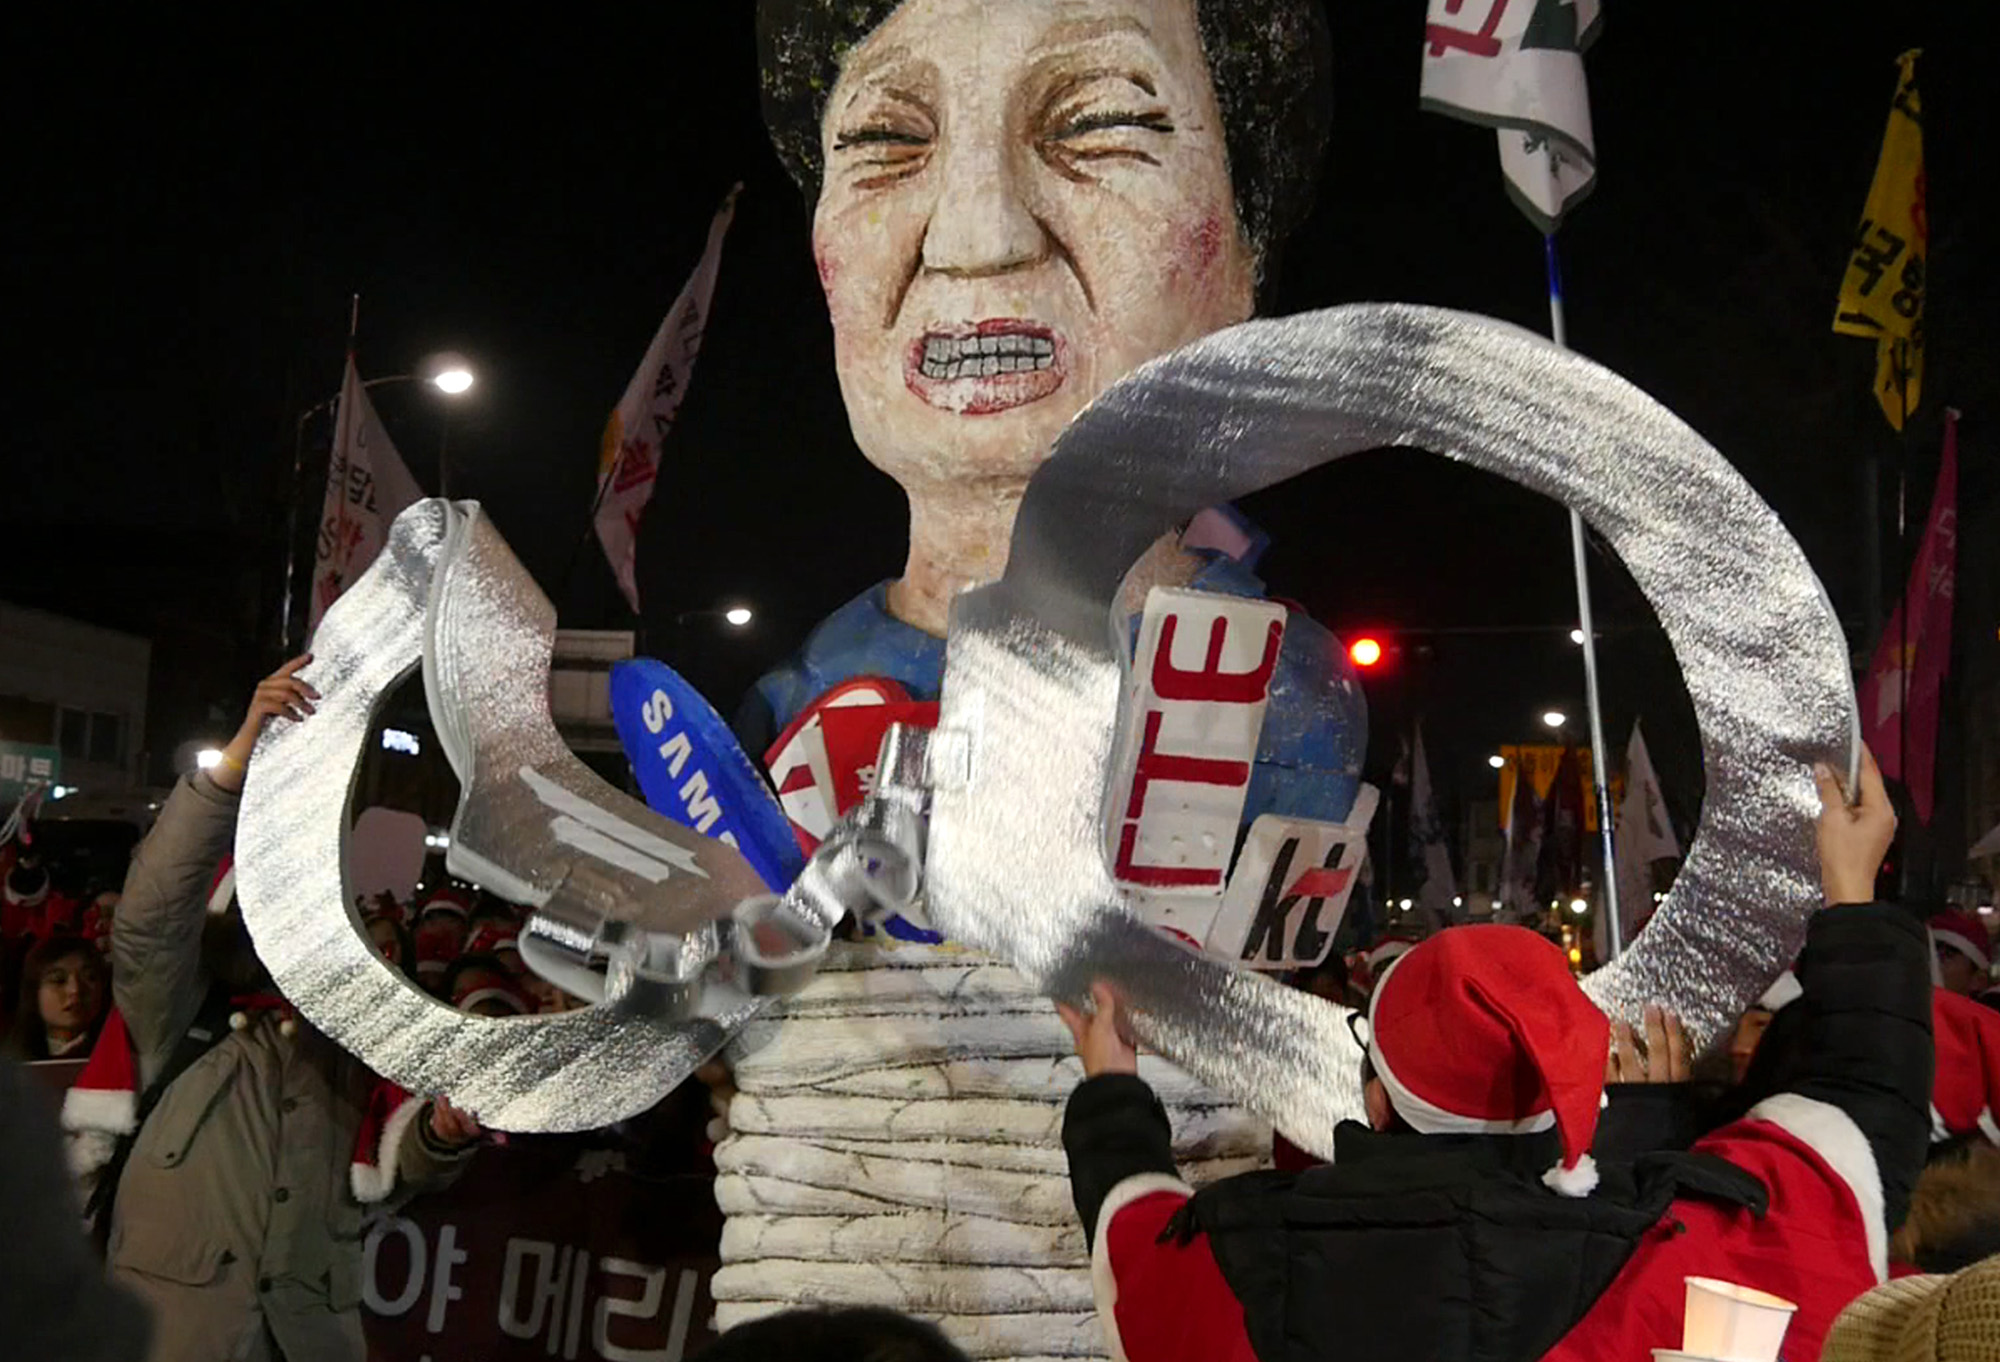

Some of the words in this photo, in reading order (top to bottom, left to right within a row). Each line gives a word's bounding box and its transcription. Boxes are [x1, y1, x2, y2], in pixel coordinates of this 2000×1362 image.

[1241, 837, 1353, 962] kt
[361, 1214, 467, 1334] 야
[498, 1236, 717, 1362] 메리
